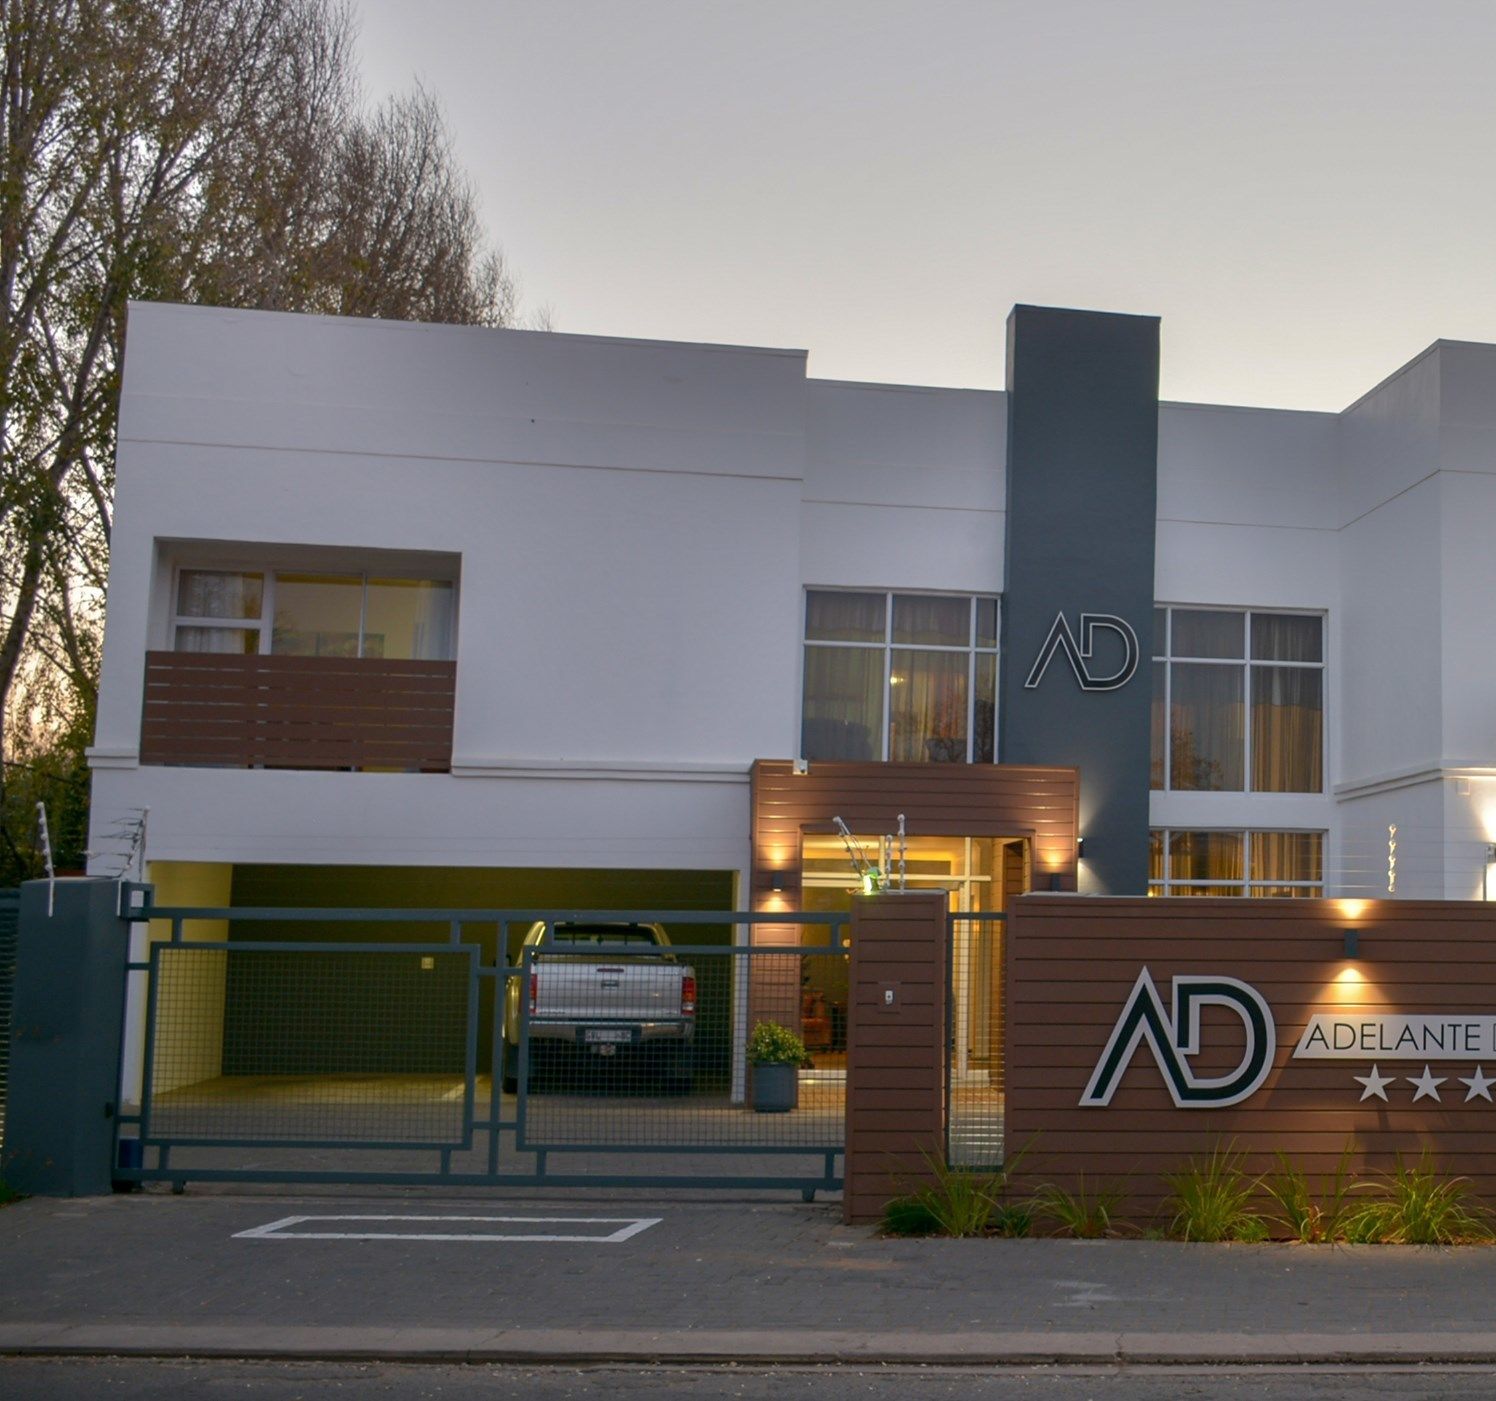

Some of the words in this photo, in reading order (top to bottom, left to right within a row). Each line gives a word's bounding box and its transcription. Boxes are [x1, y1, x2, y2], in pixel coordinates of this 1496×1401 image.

[1024, 611, 1139, 690] AD
[1078, 965, 1276, 1108] AD
[1305, 1022, 1481, 1052] ADELANTE
